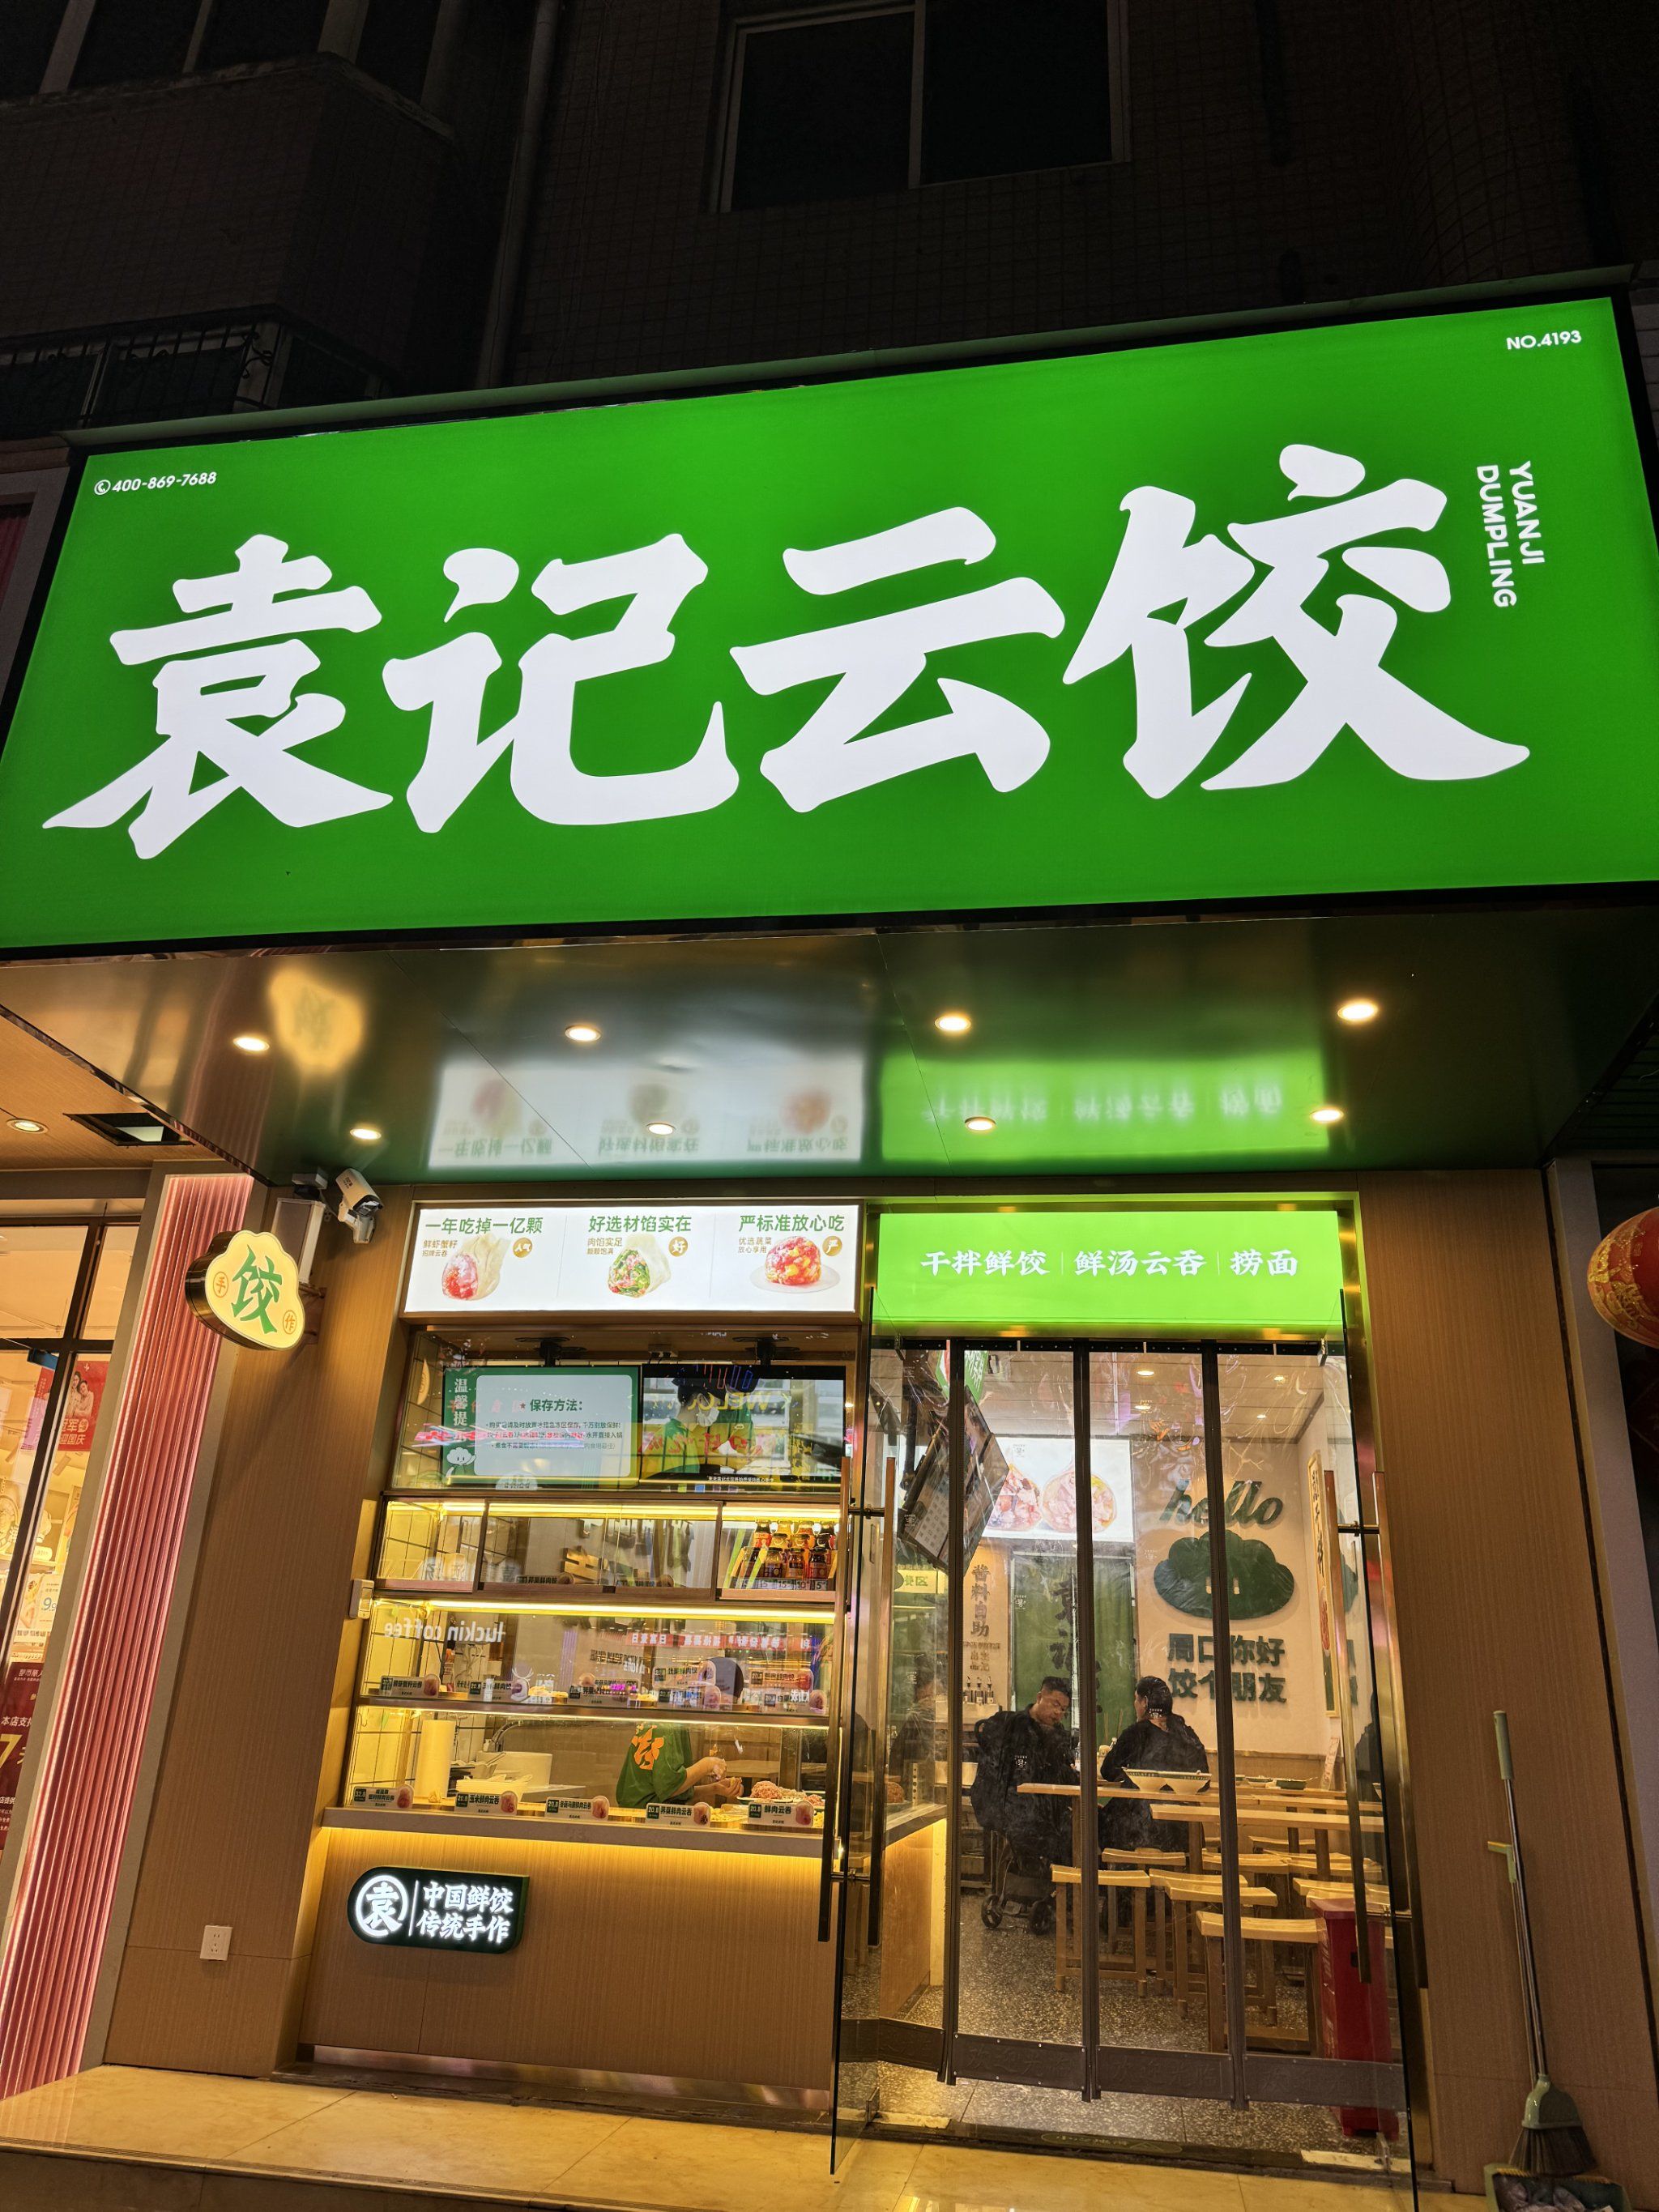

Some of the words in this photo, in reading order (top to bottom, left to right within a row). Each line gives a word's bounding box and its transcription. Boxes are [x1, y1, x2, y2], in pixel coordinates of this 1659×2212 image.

[1506, 330, 1582, 350] NO.4193
[112, 471, 217, 493] 400-869-7688
[1508, 460, 1546, 565] YUANJI
[1476, 463, 1517, 607] DUMPLING
[43, 444, 1530, 859] 袁记云饺
[425, 1217, 544, 1234] 一年吃掉一亿颗
[588, 1215, 692, 1233] 好选材馅实在
[738, 1214, 845, 1233] 严标准放心吃
[587, 1237, 623, 1247] 肉馅实足
[672, 1241, 685, 1252] 好
[825, 1239, 839, 1253] 严
[920, 1249, 1050, 1276] 干拌鲜饺
[1074, 1249, 1206, 1276] 鲜汤云吞
[1230, 1248, 1298, 1276] 捞面
[216, 1276, 226, 1294] 手
[231, 1245, 283, 1334] 饺
[285, 1314, 296, 1332] 作
[1159, 1479, 1284, 1525] hello
[1167, 1633, 1286, 1667] 周口你好
[1168, 1669, 1286, 1703] 饺个朋友
[764, 1805, 792, 1815] 鲜肉云吞
[363, 1882, 402, 1933] 袁
[422, 1881, 514, 1914] 中国鲜饺
[416, 1908, 511, 1945] 传统手作
